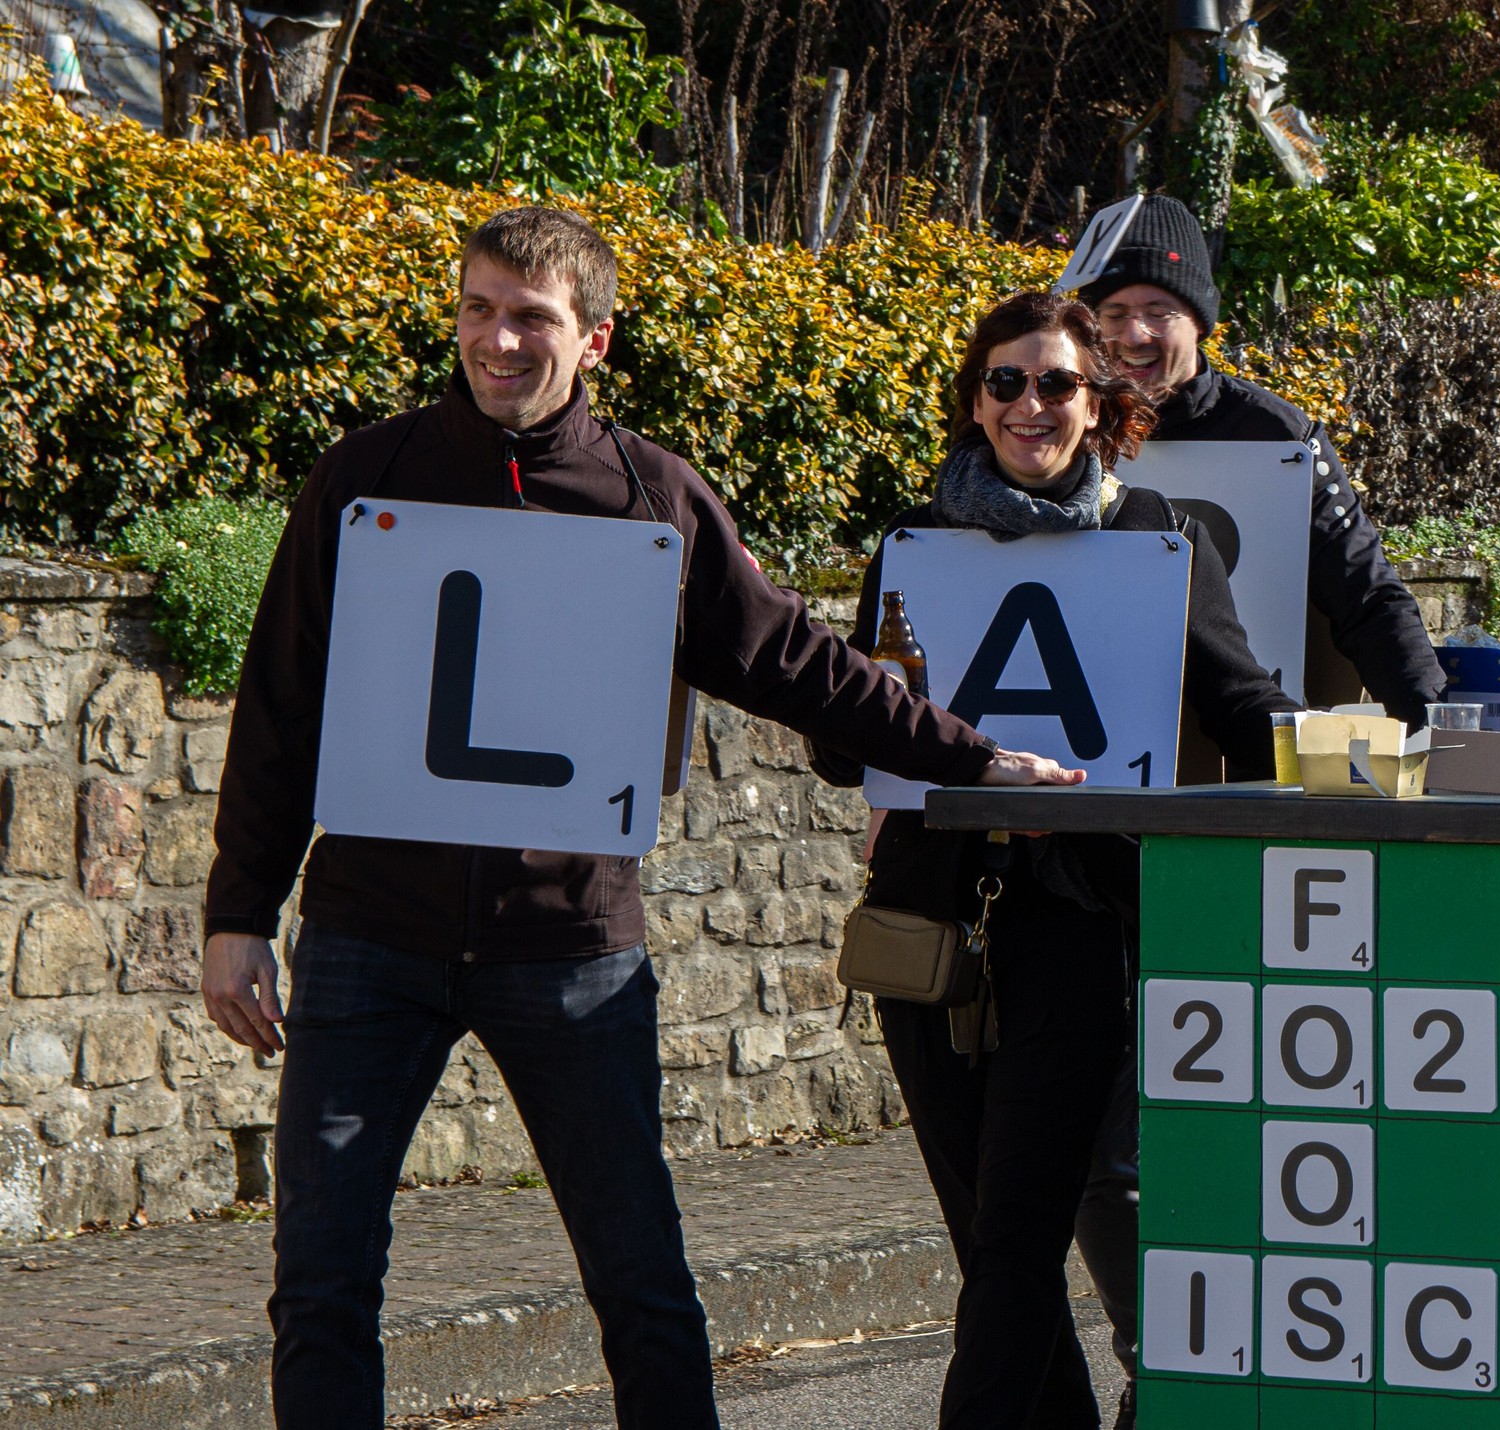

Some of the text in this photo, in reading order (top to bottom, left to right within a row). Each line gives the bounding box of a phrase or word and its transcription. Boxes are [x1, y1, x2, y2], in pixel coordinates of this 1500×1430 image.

[425, 570, 574, 787] L
[946, 582, 1108, 761] A
[608, 784, 634, 835] 1
